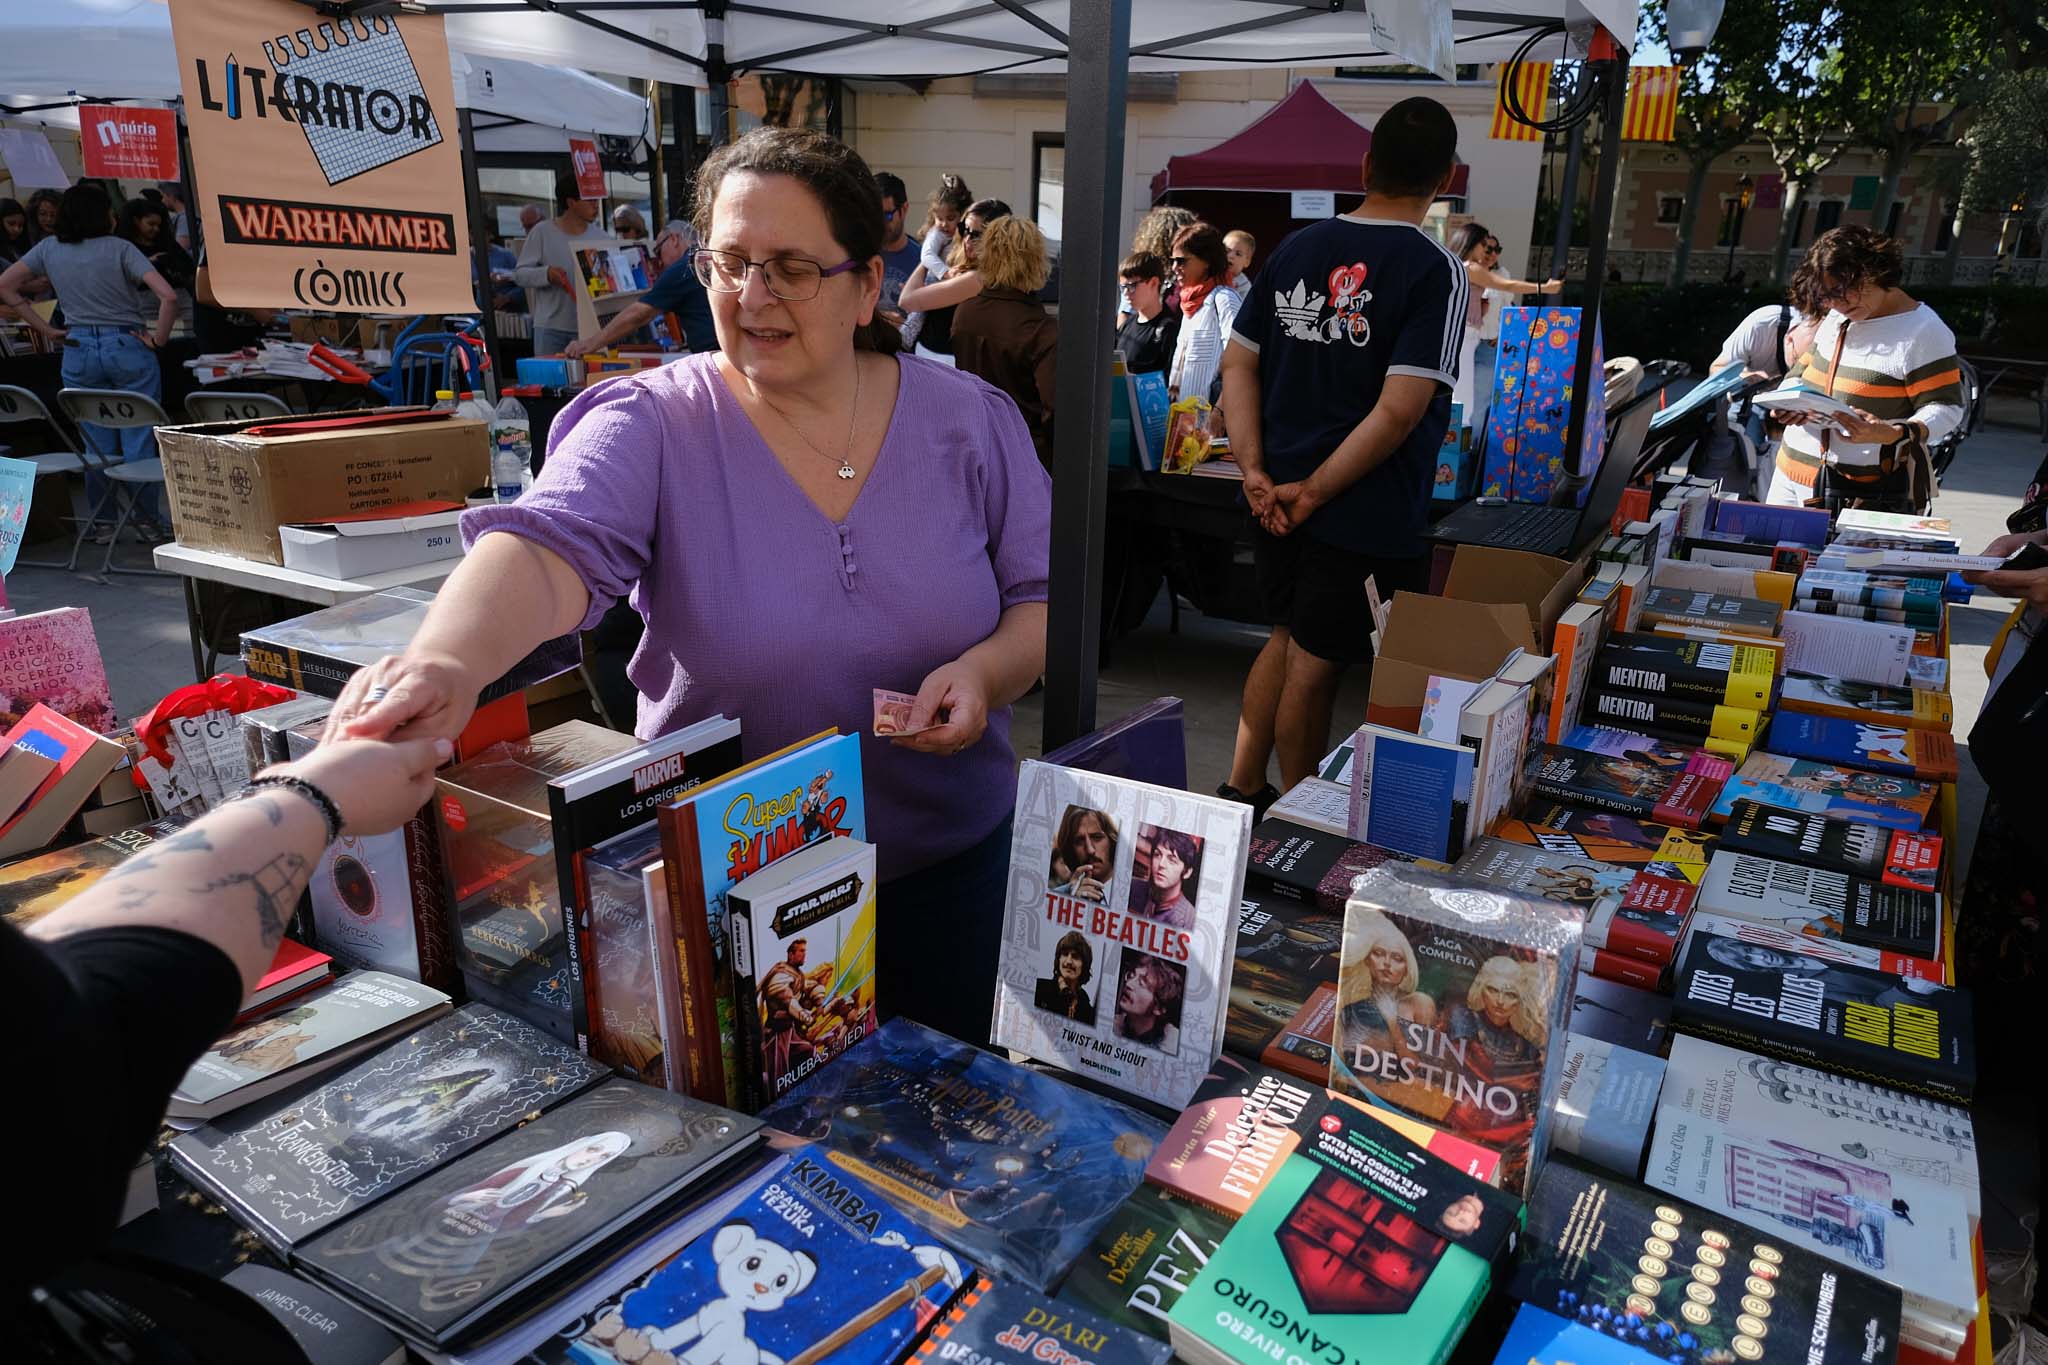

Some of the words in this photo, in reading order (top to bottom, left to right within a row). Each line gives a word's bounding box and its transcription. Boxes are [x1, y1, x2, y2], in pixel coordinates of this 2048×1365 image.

[196, 53, 433, 140] LITERATOR
[121, 121, 157, 135] núria
[227, 203, 449, 250] WARHAMMER
[294, 260, 407, 307] CÒMICS
[427, 536, 443, 548] 250
[0, 642, 59, 661] IBRERÍA
[16, 634, 34, 645] LA
[248, 647, 286, 665] STAR
[3, 657, 50, 674] ÁGICA
[57, 650, 75, 662] DE
[17, 662, 83, 683] CEREZOS
[247, 660, 288, 679] WARS
[303, 663, 349, 680] HEREDERO
[1608, 665, 1666, 692] MENTIRA
[1671, 681, 1689, 690] JUAN
[9, 685, 30, 697] EN
[33, 676, 68, 692] FLOR
[1598, 694, 1654, 722] MENTIRA
[1659, 711, 1677, 719] JUAN
[634, 753, 685, 794] MARVEL
[620, 802, 643, 818] LOS
[645, 777, 700, 808] ORÍGENES
[723, 786, 803, 861] Super
[1764, 815, 1800, 836] NO
[1265, 847, 1288, 868] Abans
[1287, 836, 1300, 852] més
[1281, 857, 1297, 872] que
[1289, 839, 1315, 862] Encara
[783, 896, 821, 921] STAR
[817, 880, 854, 906] WARS
[1728, 878, 1767, 900] ELS
[564, 906, 579, 960] ORÍGENES
[1046, 893, 1086, 930] THE
[1091, 907, 1191, 961] BEATLES
[1433, 936, 1463, 952] SAGA
[571, 960, 580, 982] LOS
[1418, 944, 1476, 968] COMPLETA
[1688, 969, 1735, 1007] TOTES
[1732, 992, 1776, 1019] LES
[1777, 973, 1825, 1031] BATALLES
[1844, 1001, 1890, 1048] MAGDA
[1893, 1002, 1941, 1060] ORANICH
[776, 1046, 829, 1093] PRUEBAS
[843, 1022, 867, 1051] JEDI
[1061, 1028, 1092, 1048] TWIST
[1091, 1040, 1113, 1056] AND
[1114, 1047, 1148, 1068] SHOUT
[1406, 1023, 1468, 1067] SIN
[1080, 1057, 1121, 1077] BOLDLETTERS
[1352, 1043, 1519, 1118] DESTINO
[1564, 1052, 1584, 1084] Montero
[1719, 1069, 1738, 1104] BLANCAS
[987, 1096, 1054, 1139] Potter
[1192, 1105, 1218, 1136] Villar
[1203, 1075, 1281, 1163] Detective
[269, 1119, 359, 1189] FRANKENSTEIN
[1220, 1082, 1312, 1199] FERRUCHI
[1318, 1130, 1348, 1151] ELLA?
[1318, 1140, 1351, 1163] MANO
[1347, 1145, 1368, 1163] POR
[1350, 1157, 1364, 1170] LA
[1368, 1155, 1402, 1182] FUEGO
[1666, 1150, 1683, 1176] Roser
[791, 1158, 881, 1235] KIMBA
[1368, 1166, 1420, 1201] ¿PONDRÍAS
[1401, 1175, 1414, 1188] EL
[1412, 1183, 1429, 1197] EN
[760, 1190, 816, 1239] TEZUKA
[768, 1183, 813, 1219] OSAMU
[1099, 1230, 1131, 1268] Jorge
[1106, 1228, 1156, 1286] Dezcallar
[255, 1288, 298, 1319] JAMES
[294, 1301, 339, 1335] CLEAR
[1733, 1245, 1782, 1359] LIBROS
[1811, 1271, 1837, 1346] SCHAUMBERG
[996, 1325, 1028, 1352] del
[1023, 1306, 1109, 1353] DIARI
[1214, 1278, 1346, 1365] CANGURO
[1215, 1310, 1291, 1362] RIVERO
